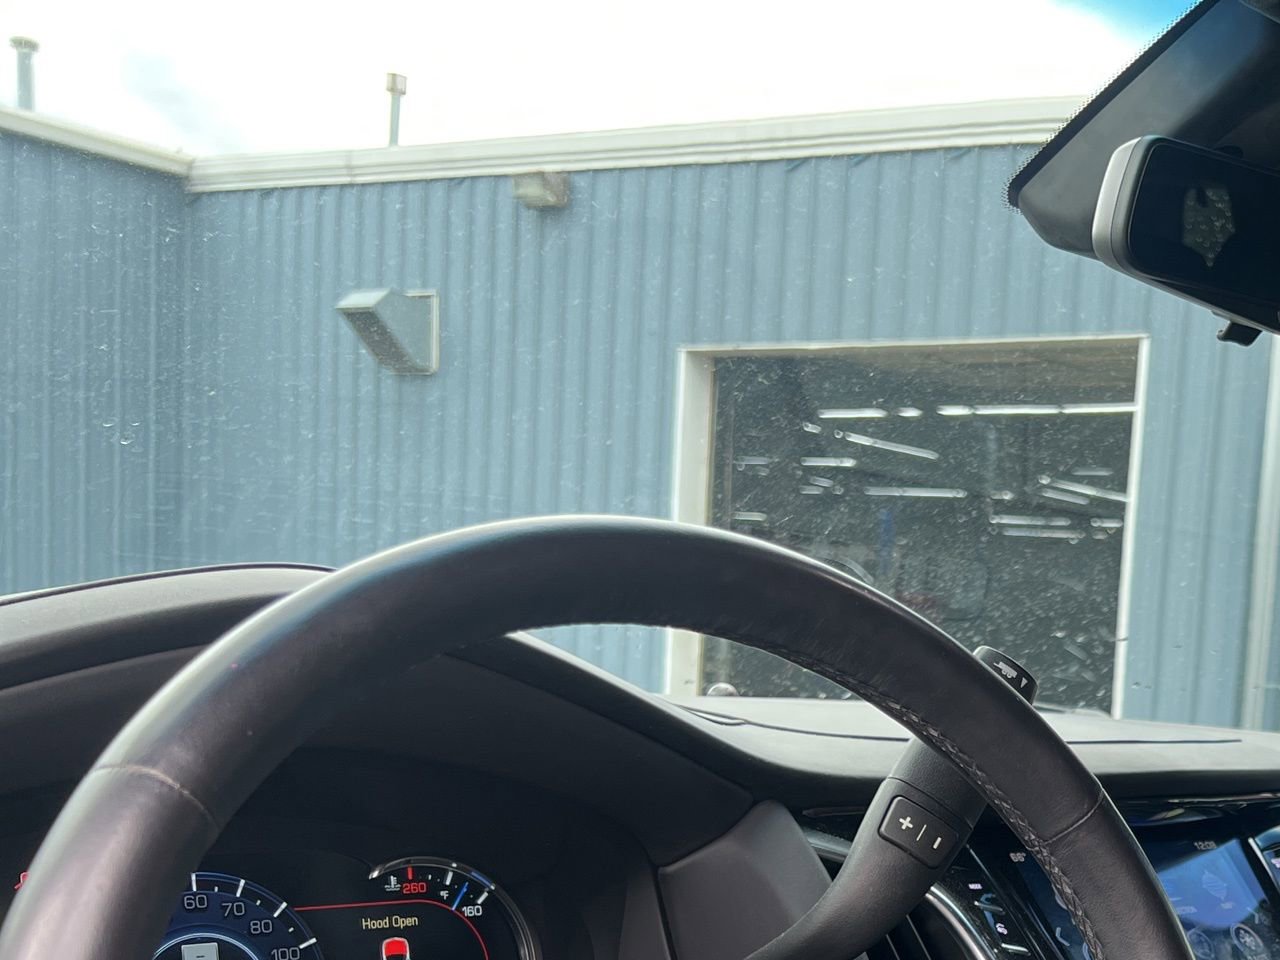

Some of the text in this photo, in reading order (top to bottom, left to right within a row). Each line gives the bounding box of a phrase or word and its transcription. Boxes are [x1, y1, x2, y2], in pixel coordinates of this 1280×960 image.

[403, 882, 427, 894] 260
[183, 894, 208, 909] 60
[222, 902, 245, 917] 70
[462, 905, 483, 917] 160
[250, 919, 272, 934] 80
[362, 915, 418, 930] Hood Open
